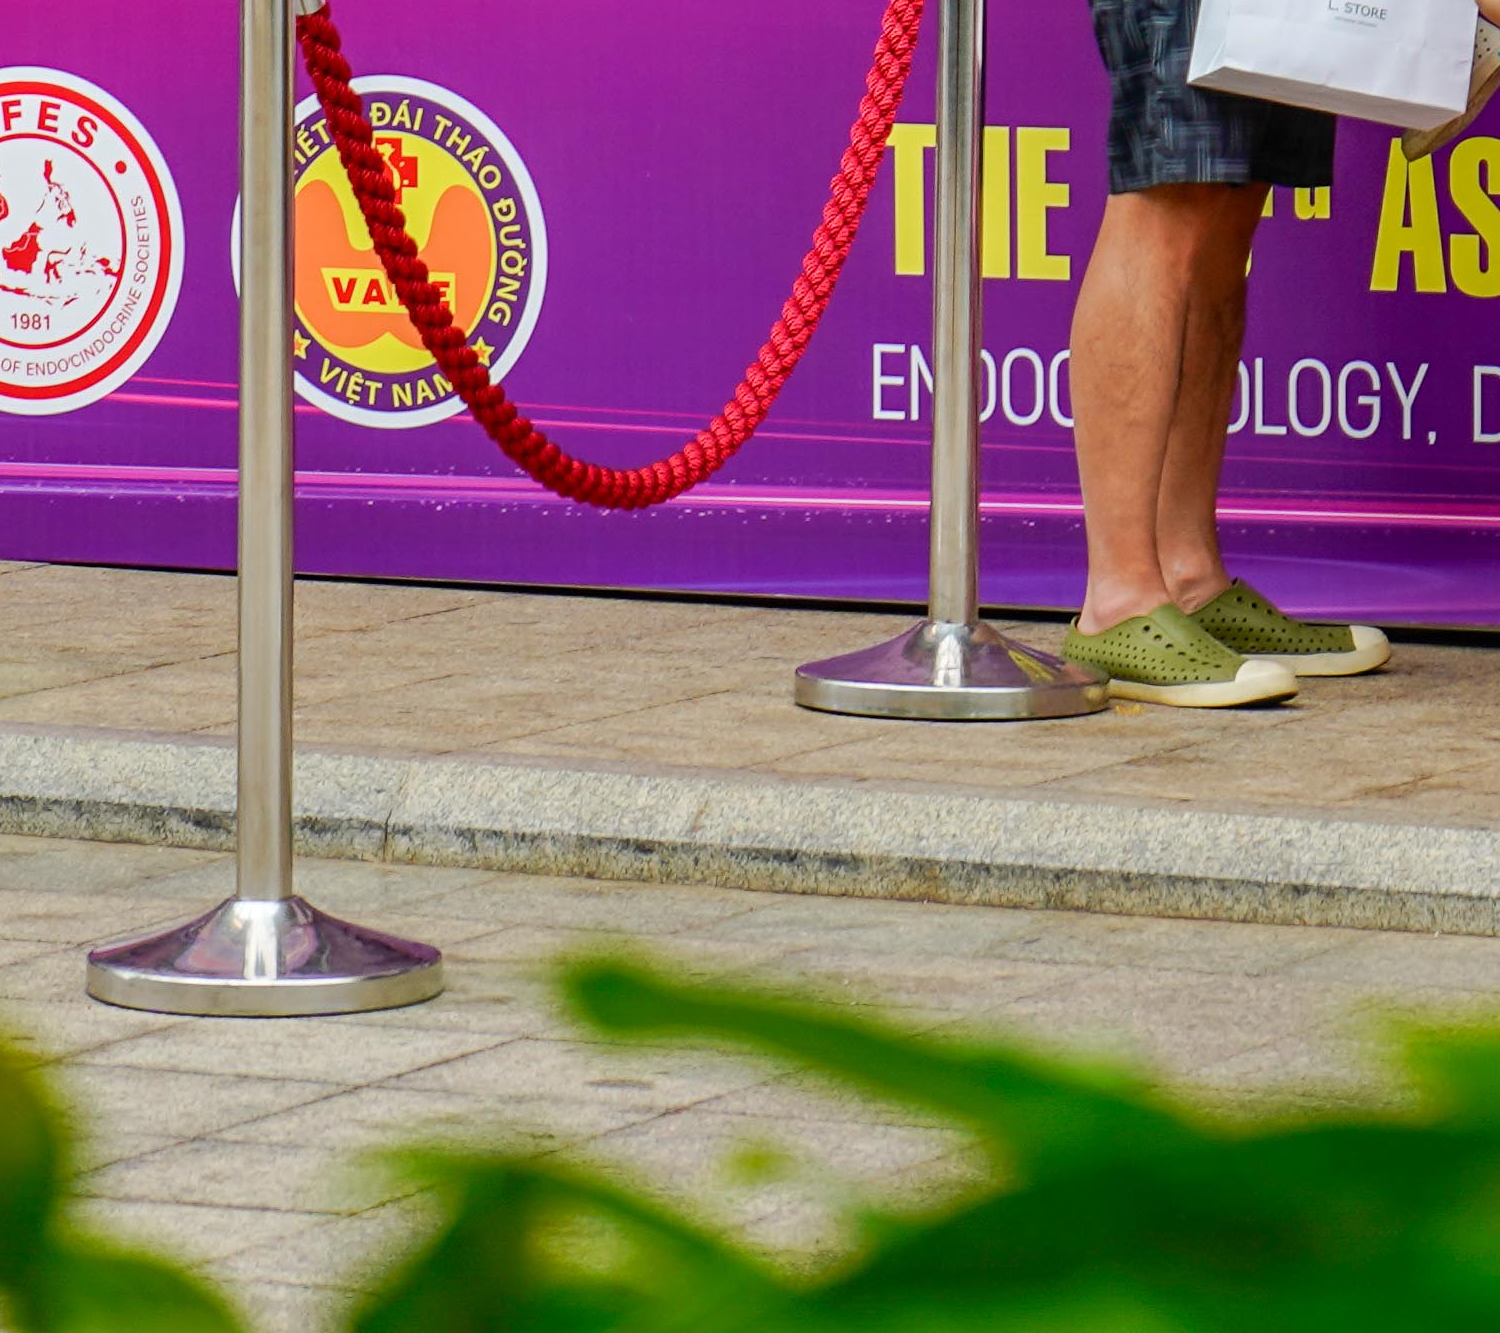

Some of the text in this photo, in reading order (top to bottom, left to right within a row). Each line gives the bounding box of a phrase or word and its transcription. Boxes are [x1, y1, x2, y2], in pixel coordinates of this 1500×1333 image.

[1344, 1, 1388, 20] STORE
[369, 99, 424, 131] ĐÁI
[435, 114, 502, 190] THÁO
[488, 196, 527, 326] ĐƯỜNG
[1, 357, 21, 374] OF
[131, 194, 151, 285] SOCIETIES
[10, 313, 51, 331] 1981
[319, 357, 383, 406] VIỆT
